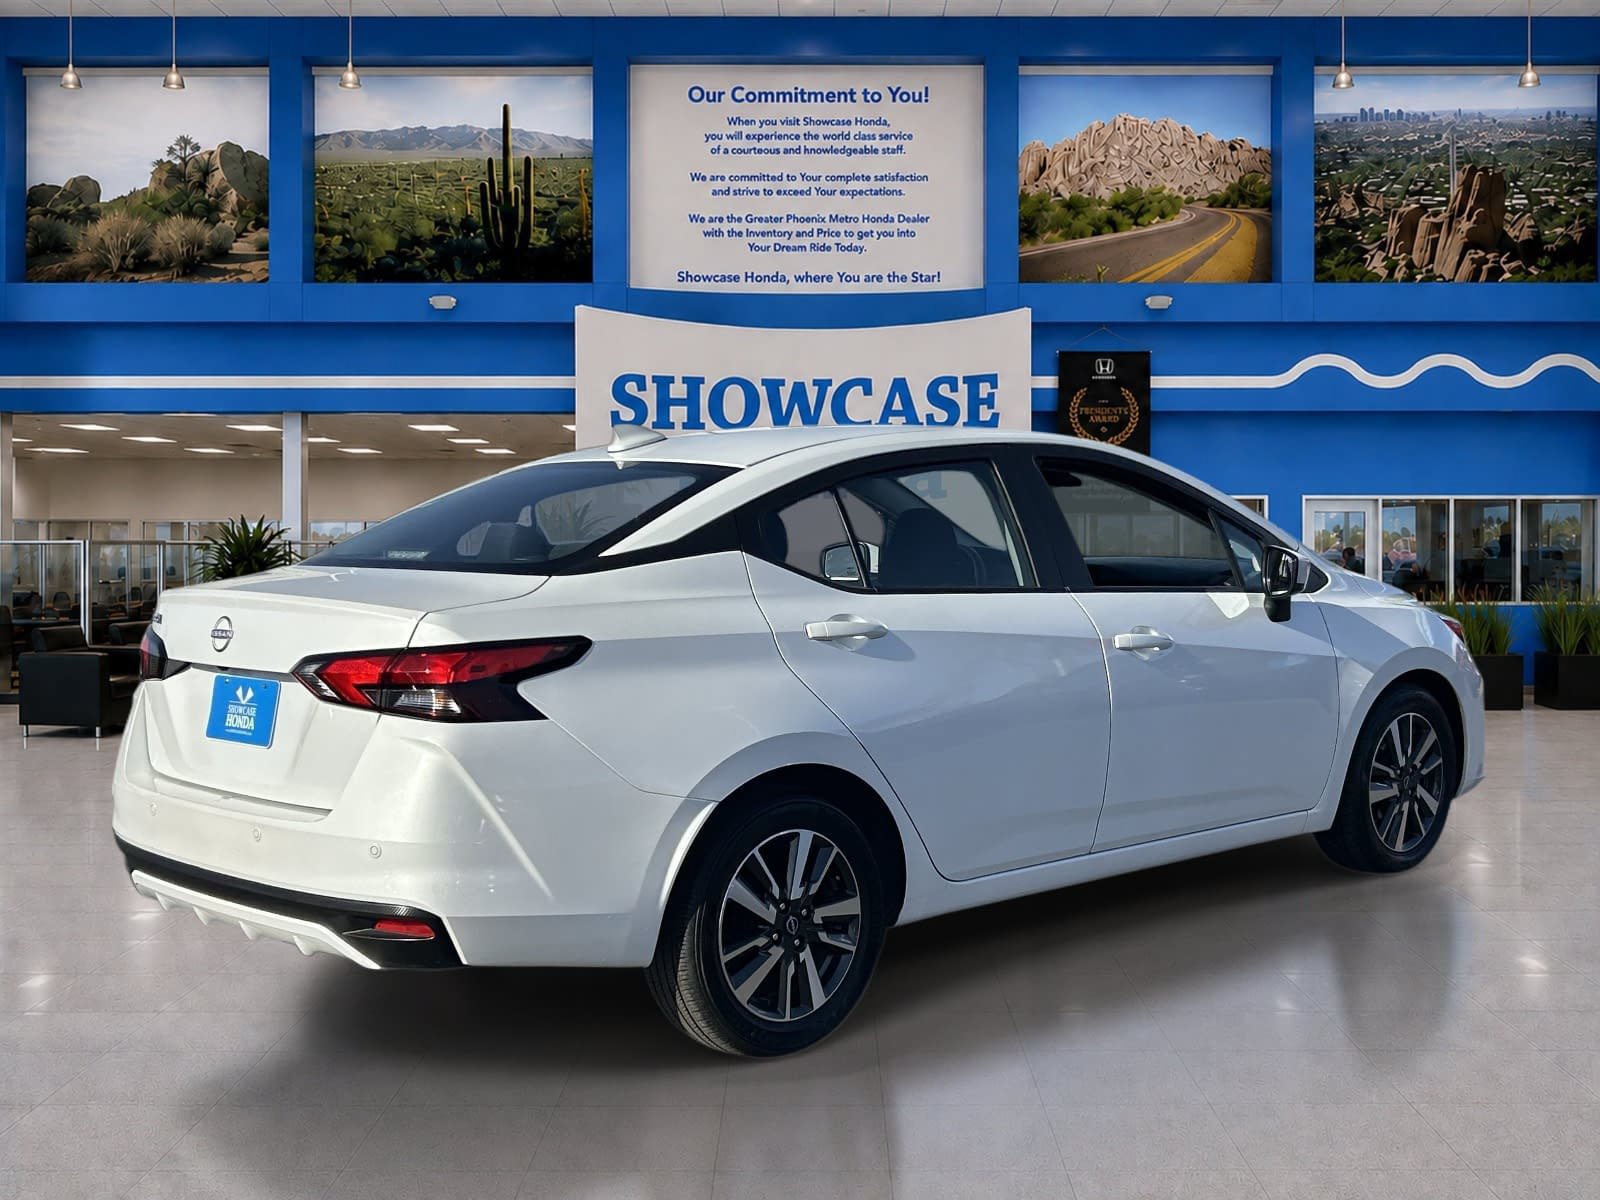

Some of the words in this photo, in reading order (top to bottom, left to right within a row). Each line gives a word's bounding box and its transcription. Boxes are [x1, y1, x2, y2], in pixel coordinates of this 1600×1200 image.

[687, 85, 727, 104] Our
[730, 85, 858, 104] Commitment
[860, 87, 883, 104] to
[886, 85, 930, 104] You!
[726, 115, 757, 127] When
[758, 118, 778, 129] you
[779, 116, 801, 127] visit
[802, 115, 853, 127] Showcase
[704, 132, 724, 144] you
[724, 130, 744, 141] will
[744, 130, 802, 144] experience
[802, 130, 821, 141] the
[821, 130, 851, 142] world
[852, 130, 877, 142] class
[878, 130, 914, 142] service
[709, 144, 722, 155] of
[722, 147, 730, 156] a
[730, 146, 781, 156] courteous
[782, 144, 802, 156] and
[881, 144, 907, 156] staff.
[689, 171, 708, 183] We
[708, 174, 727, 182] are
[727, 171, 784, 183] committed
[785, 173, 798, 183] to
[799, 172, 823, 183] Your
[824, 171, 872, 185] complete
[873, 171, 929, 183] satisfaction
[711, 185, 731, 197] and
[732, 186, 761, 197] strive
[762, 187, 774, 197] to
[775, 186, 812, 197] exceed
[813, 186, 838, 197] Your
[838, 186, 906, 200] expectations.
[687, 213, 706, 225] We
[707, 215, 725, 224] are
[725, 212, 744, 224] the
[744, 213, 785, 224] Greater
[785, 213, 827, 224] Phoenix
[828, 213, 860, 224] Metro
[861, 213, 895, 224] Honda
[897, 213, 931, 224] Dealer
[702, 227, 725, 238] with
[726, 227, 744, 239] the
[745, 227, 794, 241] Inventory
[794, 227, 815, 239] and
[816, 227, 842, 239] Price
[843, 229, 855, 239] to
[856, 229, 875, 241] get
[875, 229, 895, 241] you
[896, 227, 917, 239] into
[747, 242, 772, 253] Your
[772, 242, 808, 253] Dream
[809, 242, 833, 253] Ride
[833, 242, 868, 255] Today.
[676, 270, 741, 284] Showcase
[793, 270, 834, 284] where
[836, 271, 861, 284] You
[863, 273, 884, 284] are
[886, 270, 908, 284] the
[910, 270, 941, 284] Star!
[610, 372, 1001, 430] SHOWCASE
[227, 704, 257, 717] SHOWCASE
[225, 714, 255, 730] HONDA
